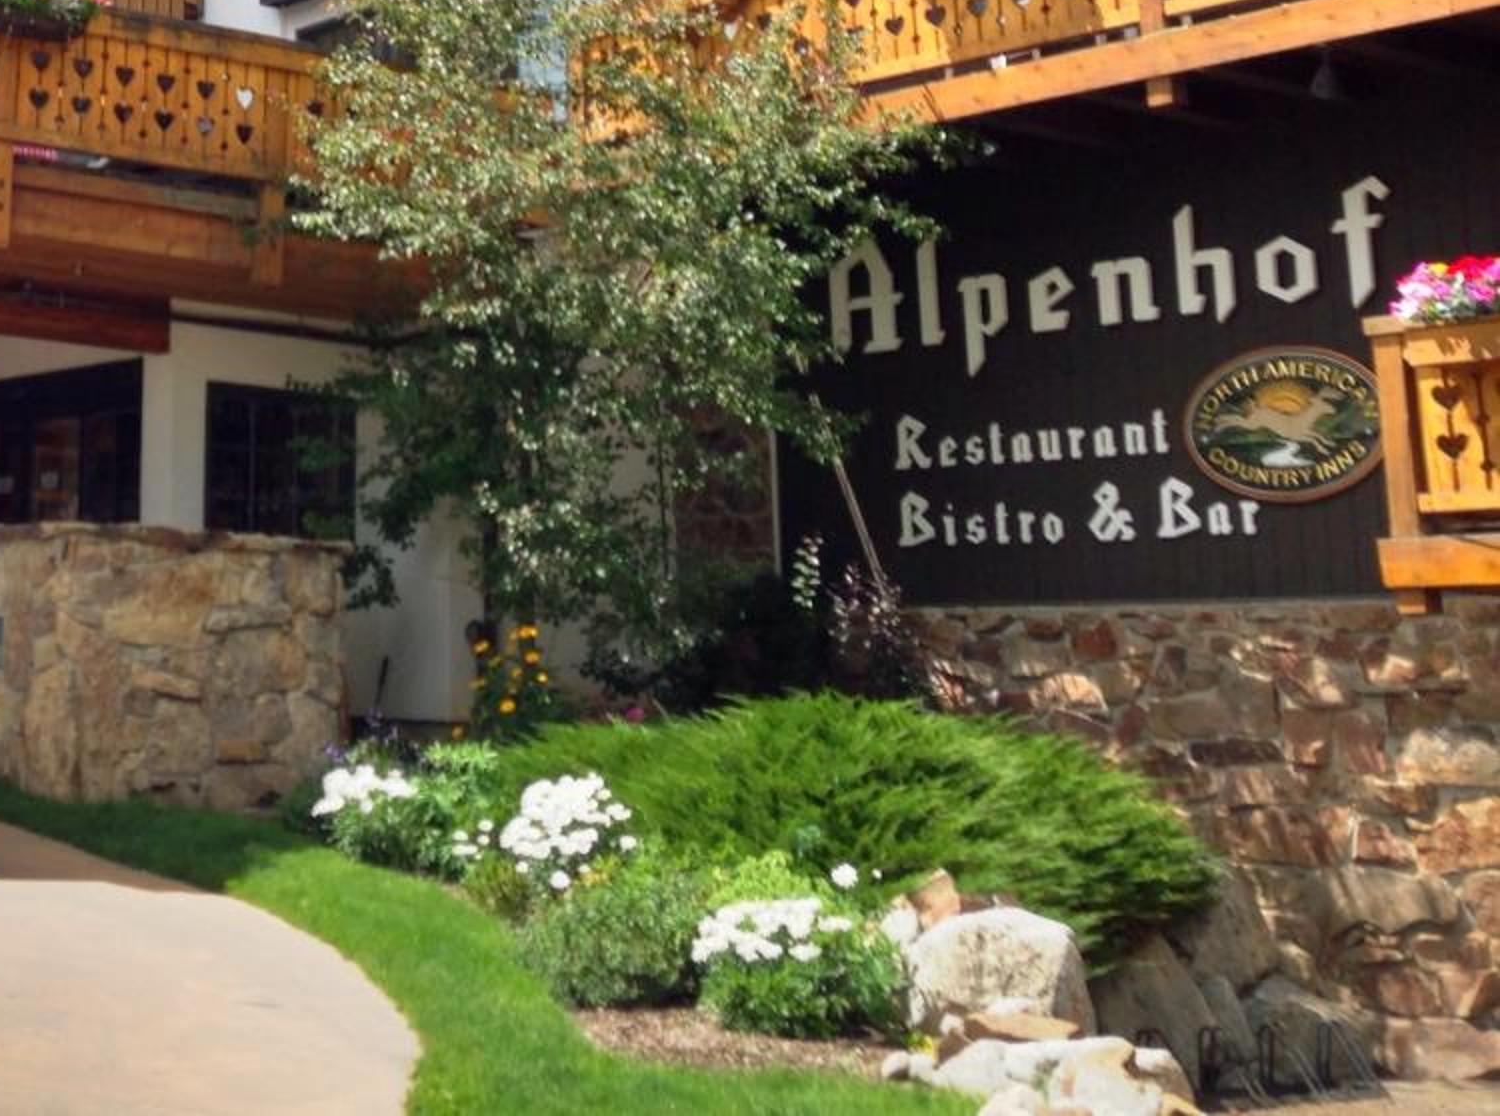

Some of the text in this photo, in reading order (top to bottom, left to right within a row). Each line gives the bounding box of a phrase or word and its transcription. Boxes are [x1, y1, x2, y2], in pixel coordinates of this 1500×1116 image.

[829, 175, 1390, 378] Alpenhof
[1196, 368, 1260, 433] NORTH
[895, 408, 1169, 471] Restaurant
[1208, 441, 1367, 487] COUNTRY INNS
[897, 476, 1260, 547] Bistro & Bar
